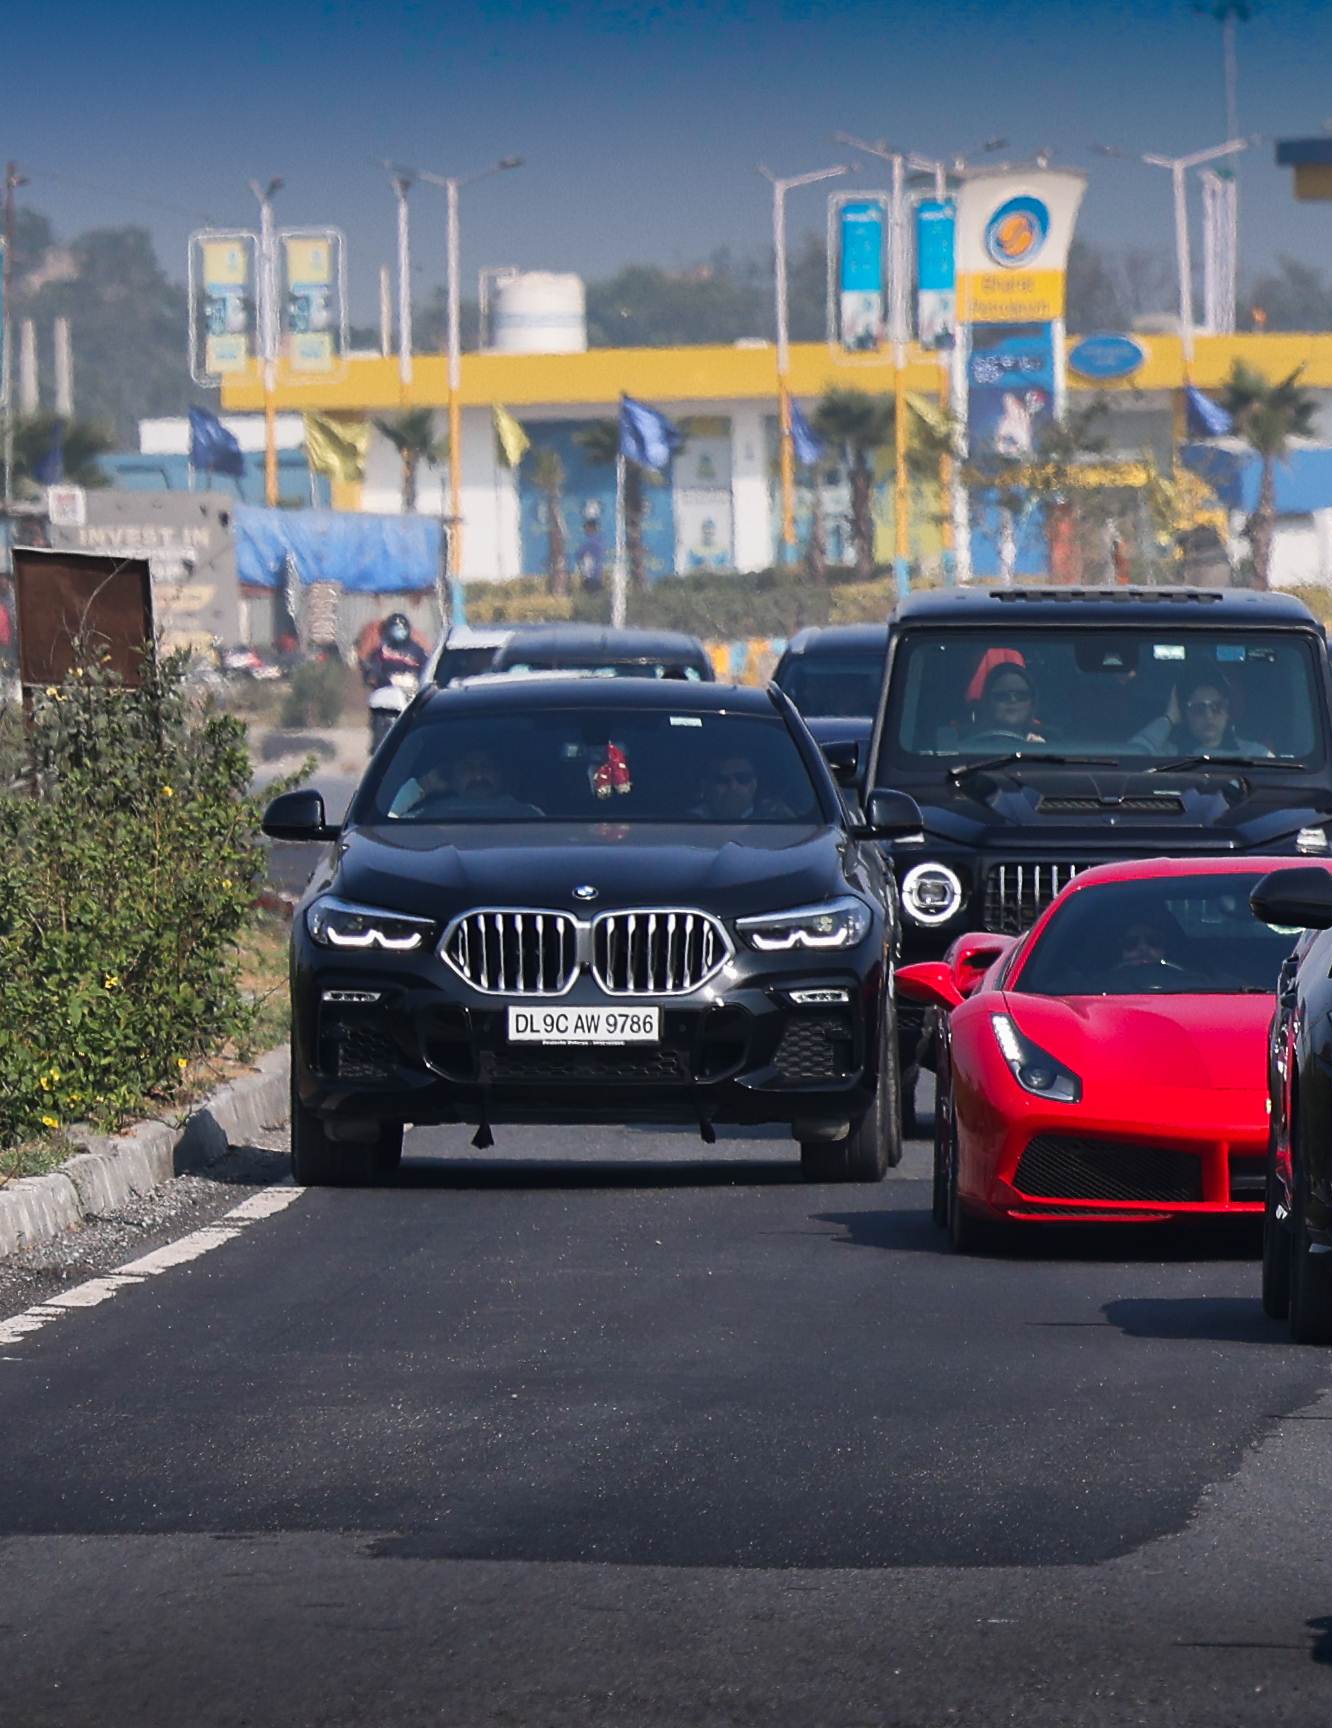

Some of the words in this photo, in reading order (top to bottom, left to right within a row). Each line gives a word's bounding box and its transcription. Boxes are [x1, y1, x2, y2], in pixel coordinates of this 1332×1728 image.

[79, 528, 174, 546] INVEST
[183, 527, 210, 546] IN
[515, 1014, 568, 1034] DL9C
[573, 1014, 600, 1034] AW
[605, 1014, 653, 1034] 9786
